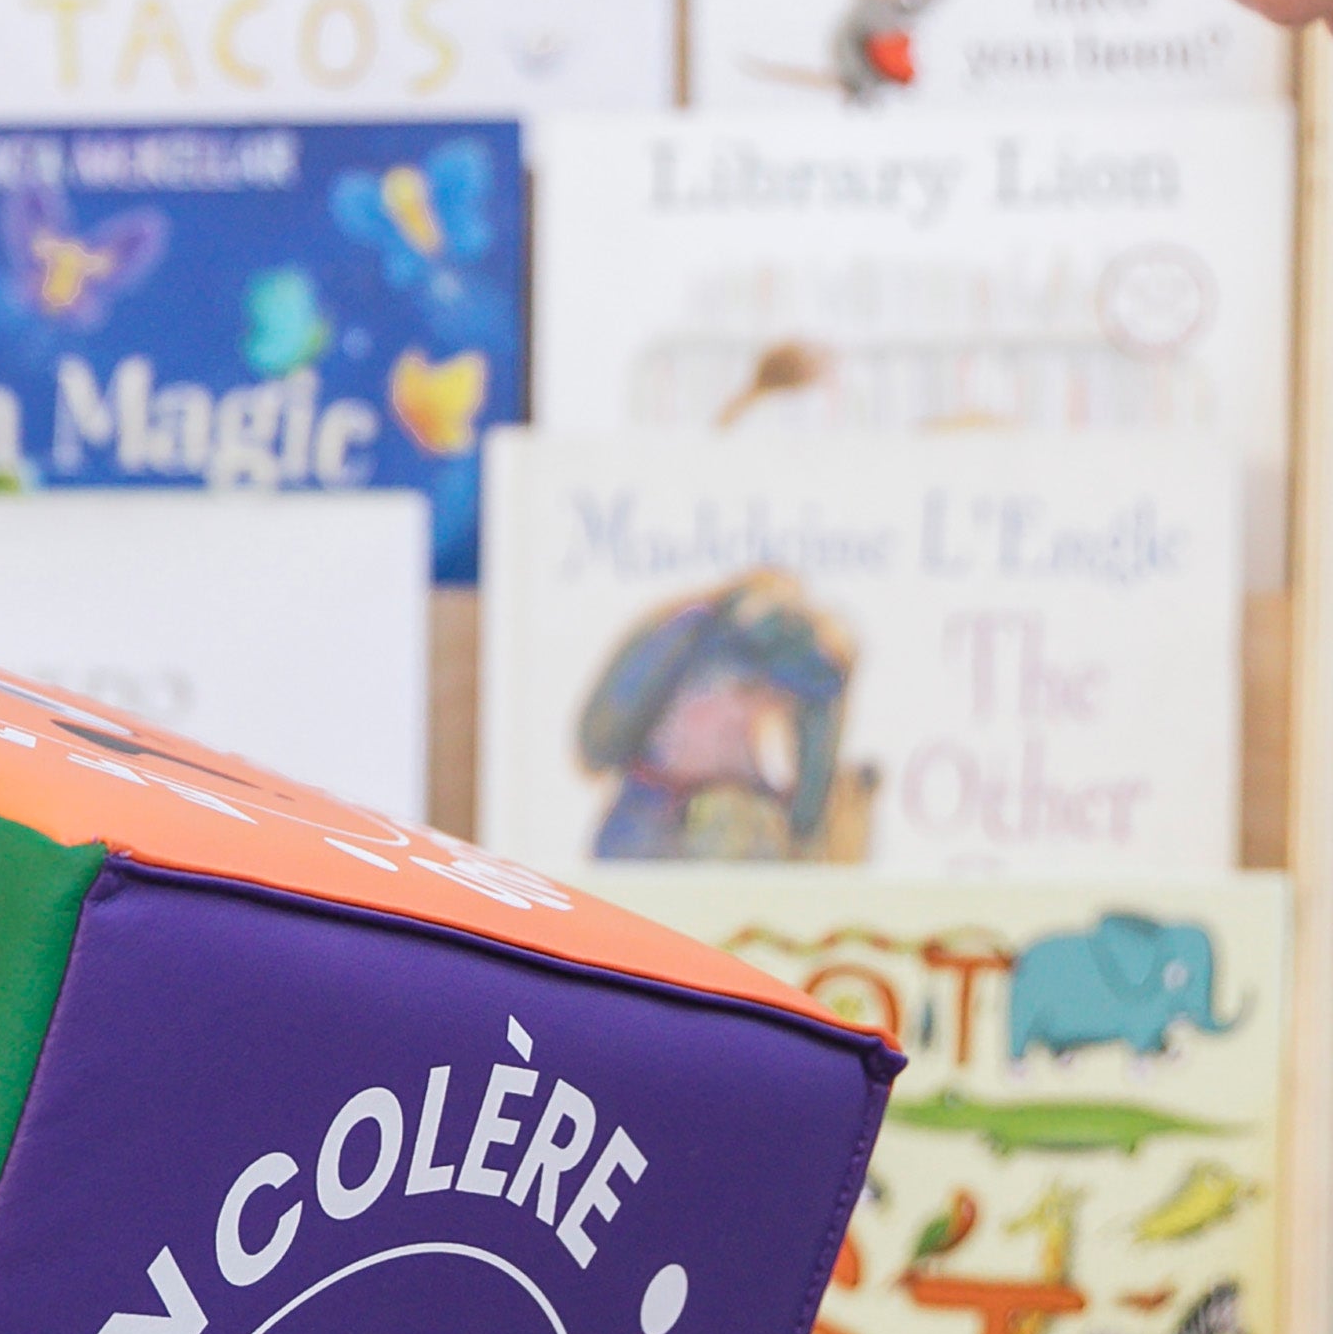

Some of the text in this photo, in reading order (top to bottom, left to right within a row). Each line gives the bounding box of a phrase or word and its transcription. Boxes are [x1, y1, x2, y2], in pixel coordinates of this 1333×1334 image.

[650, 135, 1182, 229] Library Lion
[53, 355, 379, 491] Magic
[940, 611, 1110, 725] The
[900, 737, 1153, 843] Other
